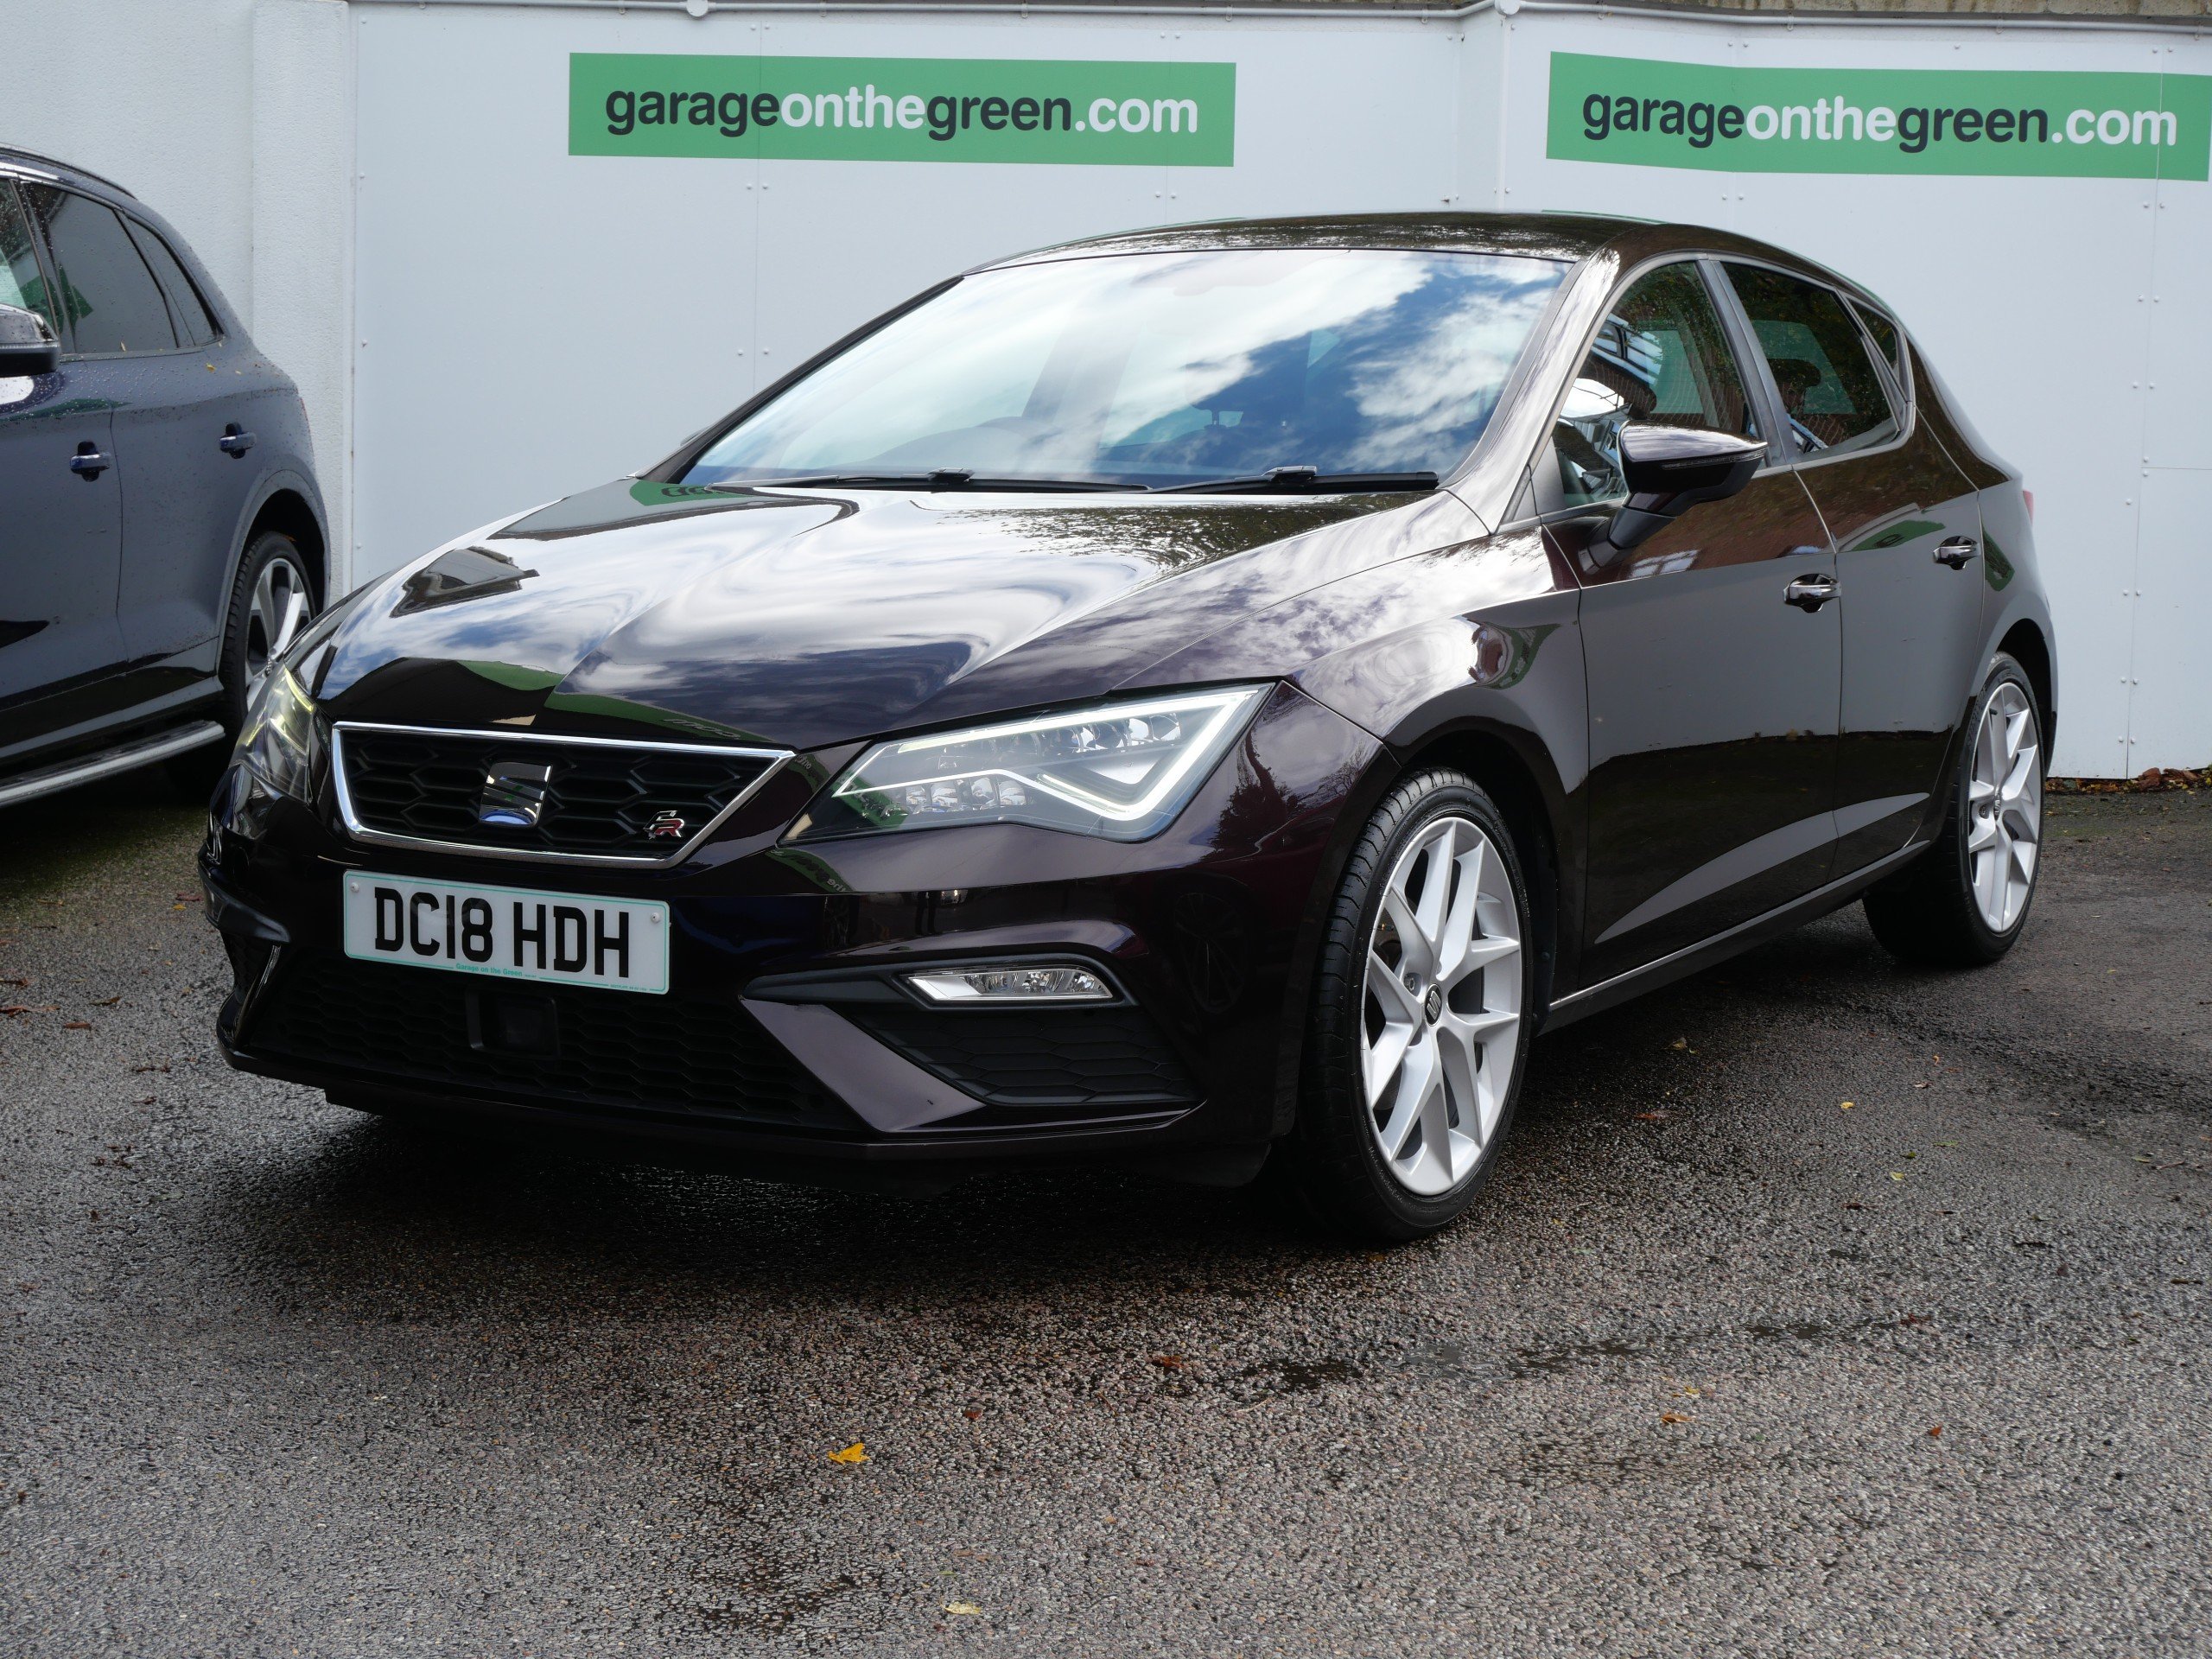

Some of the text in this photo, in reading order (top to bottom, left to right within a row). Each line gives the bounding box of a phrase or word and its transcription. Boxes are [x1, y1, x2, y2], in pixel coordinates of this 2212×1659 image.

[605, 84, 1198, 142] garageonthegreen.com
[1582, 93, 2177, 154] garageonthegreen.com
[374, 887, 629, 978] DC18 HDH
[456, 963, 479, 972] Garage
[503, 968, 523, 977] Green
